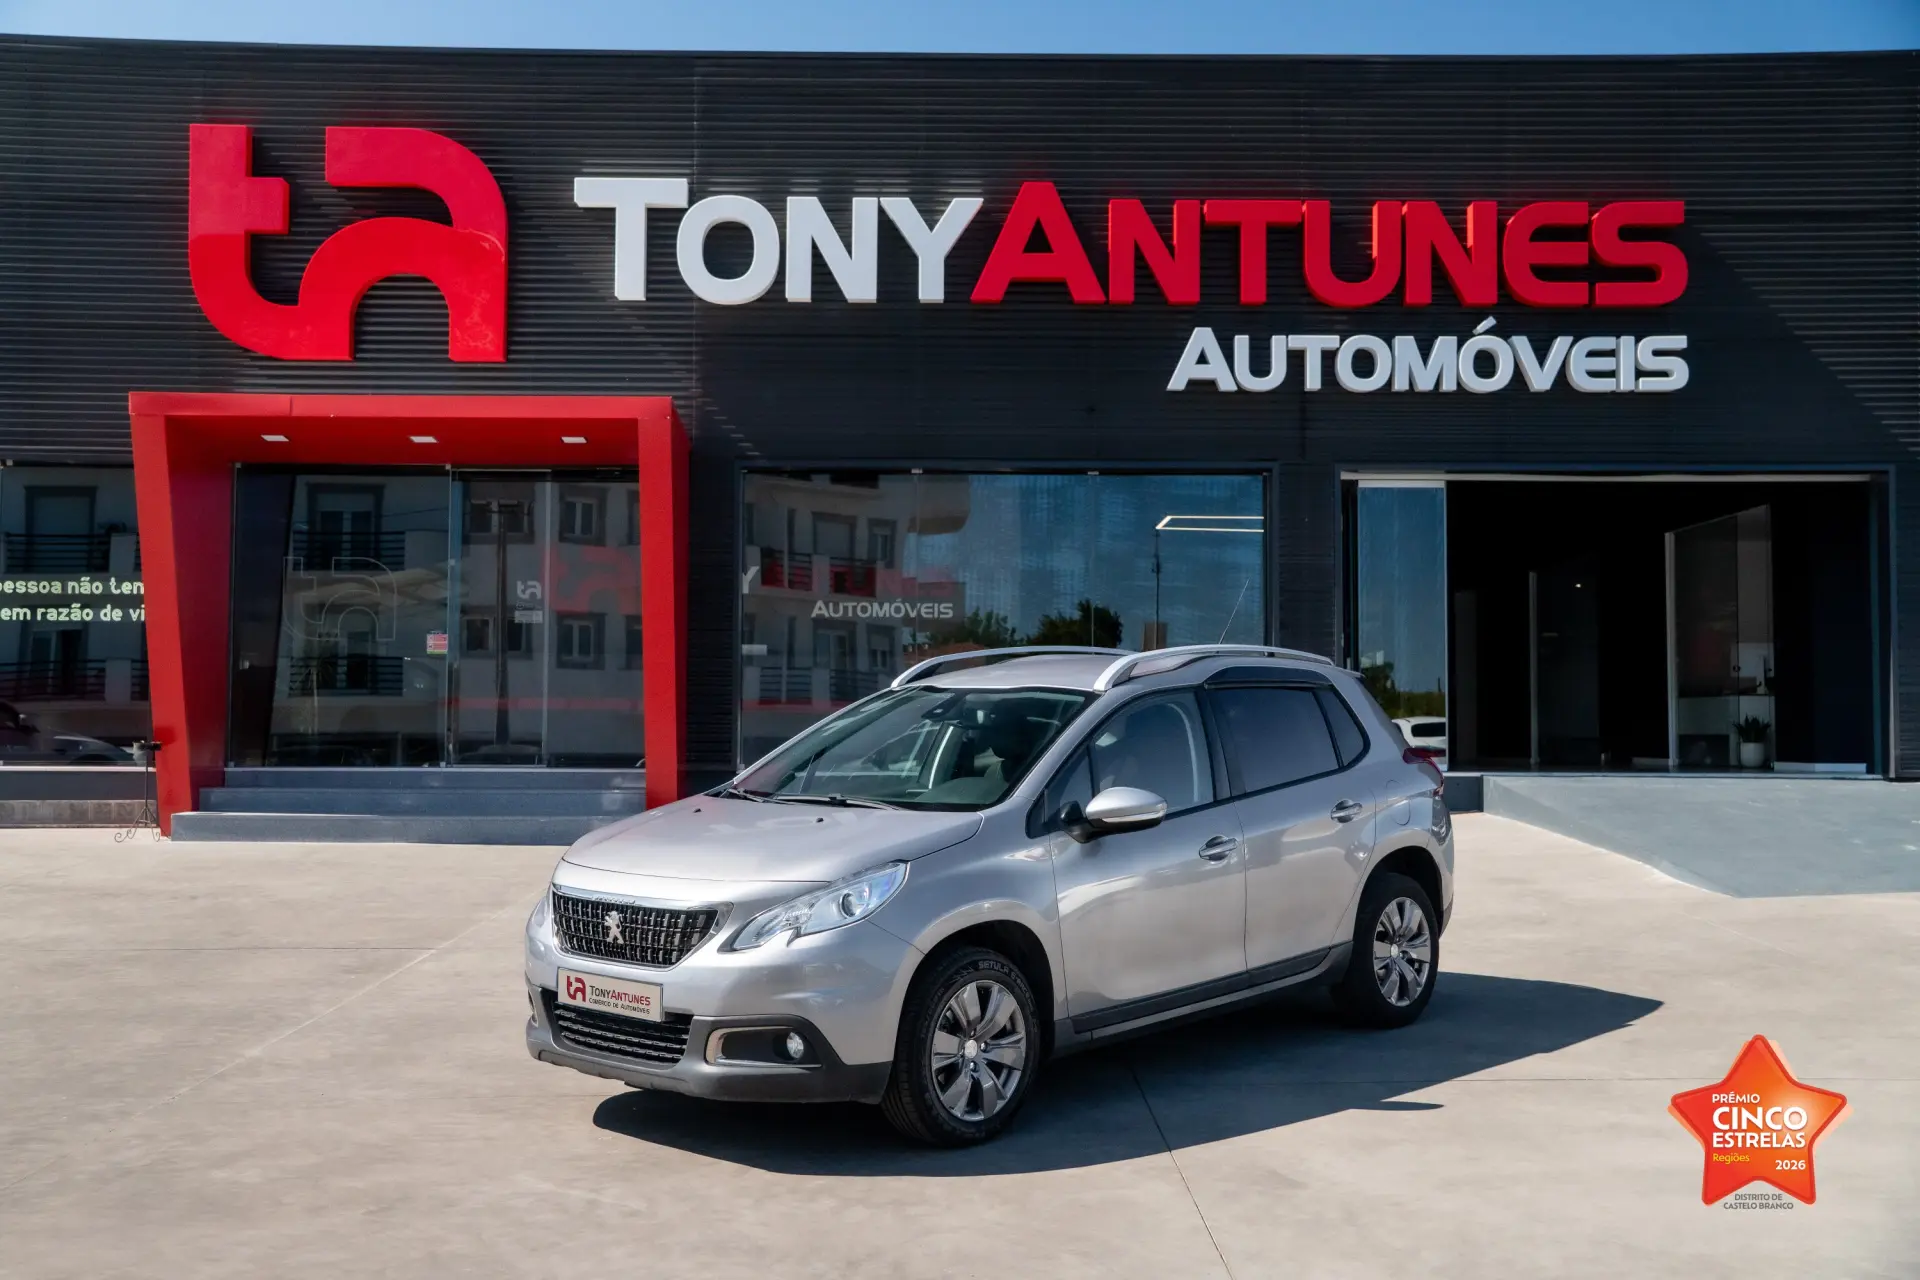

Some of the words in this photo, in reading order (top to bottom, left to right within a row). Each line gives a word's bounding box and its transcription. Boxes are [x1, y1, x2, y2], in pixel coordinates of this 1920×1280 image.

[1166, 316, 1690, 394] AUTOMÓVEIS
[68, 576, 103, 595] não
[36, 603, 94, 621] razão
[99, 604, 123, 621] de
[811, 598, 953, 619] AUTOMÓVEIS
